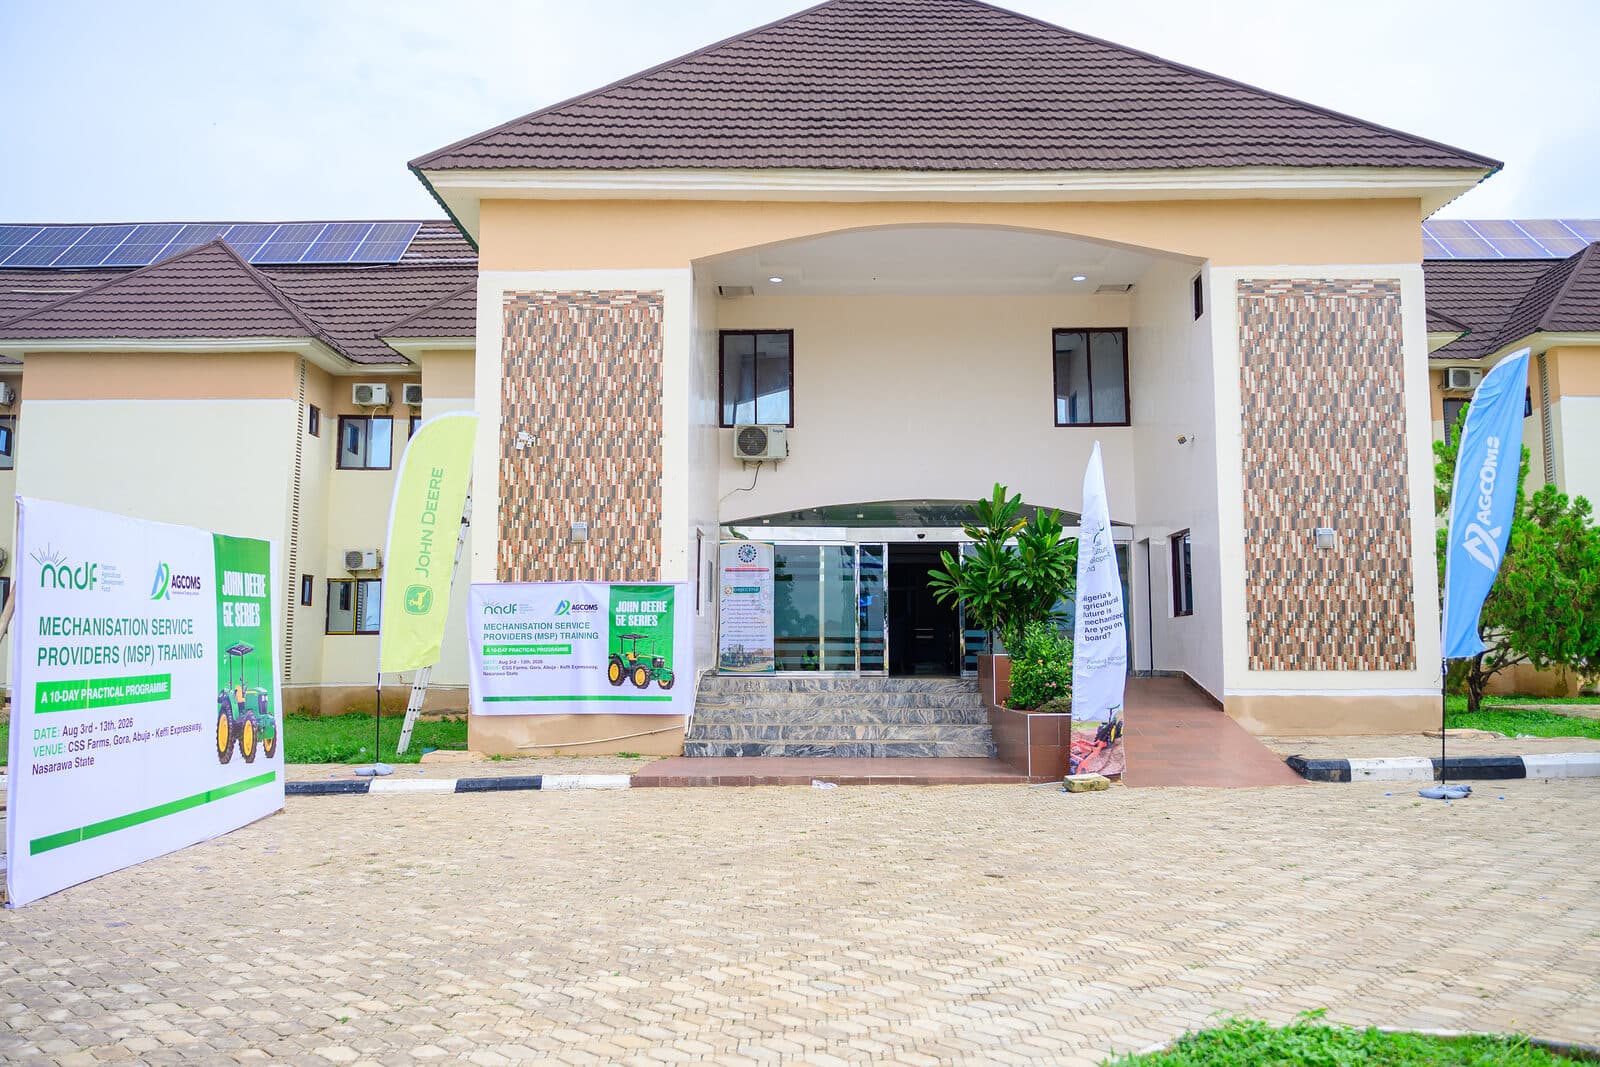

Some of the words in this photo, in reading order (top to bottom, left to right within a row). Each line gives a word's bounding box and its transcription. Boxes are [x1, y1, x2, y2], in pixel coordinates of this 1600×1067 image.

[1476, 435, 1500, 526] AGCOMS
[420, 467, 444, 526] DEERE
[415, 529, 434, 578] JOHN
[41, 561, 97, 591] nadf
[171, 574, 201, 590] AGCOMS
[222, 570, 243, 597] JOHN
[244, 572, 266, 598] DEERE
[234, 602, 261, 627] SERIES
[484, 603, 517, 615] nadf
[616, 600, 639, 613] JOHN
[640, 600, 668, 613] DEERE
[39, 616, 149, 636] MECHANISATION
[151, 618, 193, 635] SERVICE
[483, 622, 553, 631] MECHANISATION
[554, 622, 591, 630] SERVICE
[628, 614, 659, 627] SERIES
[1099, 624, 1113, 633] you
[1113, 621, 1123, 629] on
[483, 633, 533, 641] PROVIDERS
[534, 632, 558, 641] (MSP)
[559, 631, 599, 640] TRAINING
[1084, 631, 1112, 641] board?
[37, 645, 120, 667] PROVIDERS
[123, 644, 155, 667] (MSP)
[157, 642, 203, 661] TRAINING
[40, 691, 48, 704] A
[49, 689, 79, 703] 10-DAY
[80, 685, 124, 700] PRACTICAL
[125, 681, 169, 697] PROGRAMME
[33, 726, 61, 741] DATE:
[62, 724, 78, 738] Aug
[80, 722, 93, 734] 3rd
[33, 742, 66, 757] VENUE:
[68, 739, 85, 753] CSS
[87, 737, 111, 751] Farms,
[132, 731, 151, 743] Abuja
[32, 760, 73, 776] Nasarawa
[74, 755, 95, 769] State
